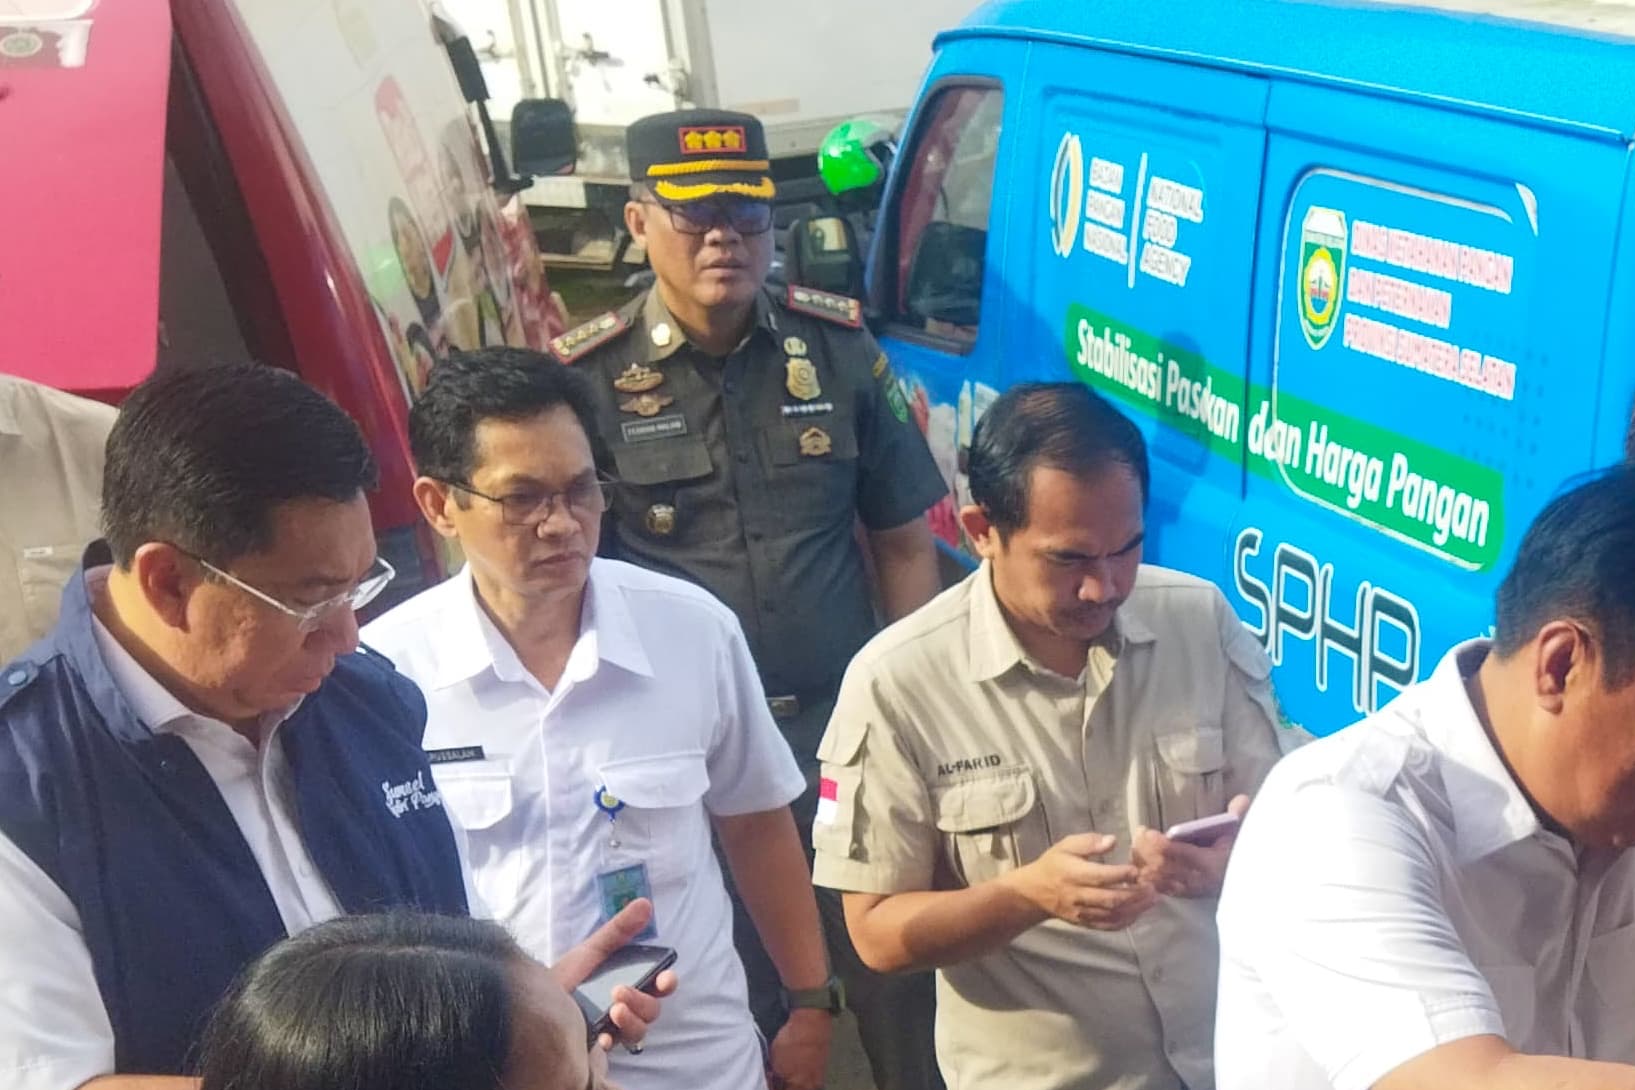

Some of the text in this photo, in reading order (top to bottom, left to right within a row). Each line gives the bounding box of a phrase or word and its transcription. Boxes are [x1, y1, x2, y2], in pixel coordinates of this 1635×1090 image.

[1077, 318, 1163, 403] Stabilisasi
[1247, 400, 1302, 468] dan
[1304, 420, 1385, 510] Harga
[1386, 452, 1490, 548] Pangan
[1234, 527, 1421, 717] SPHP
